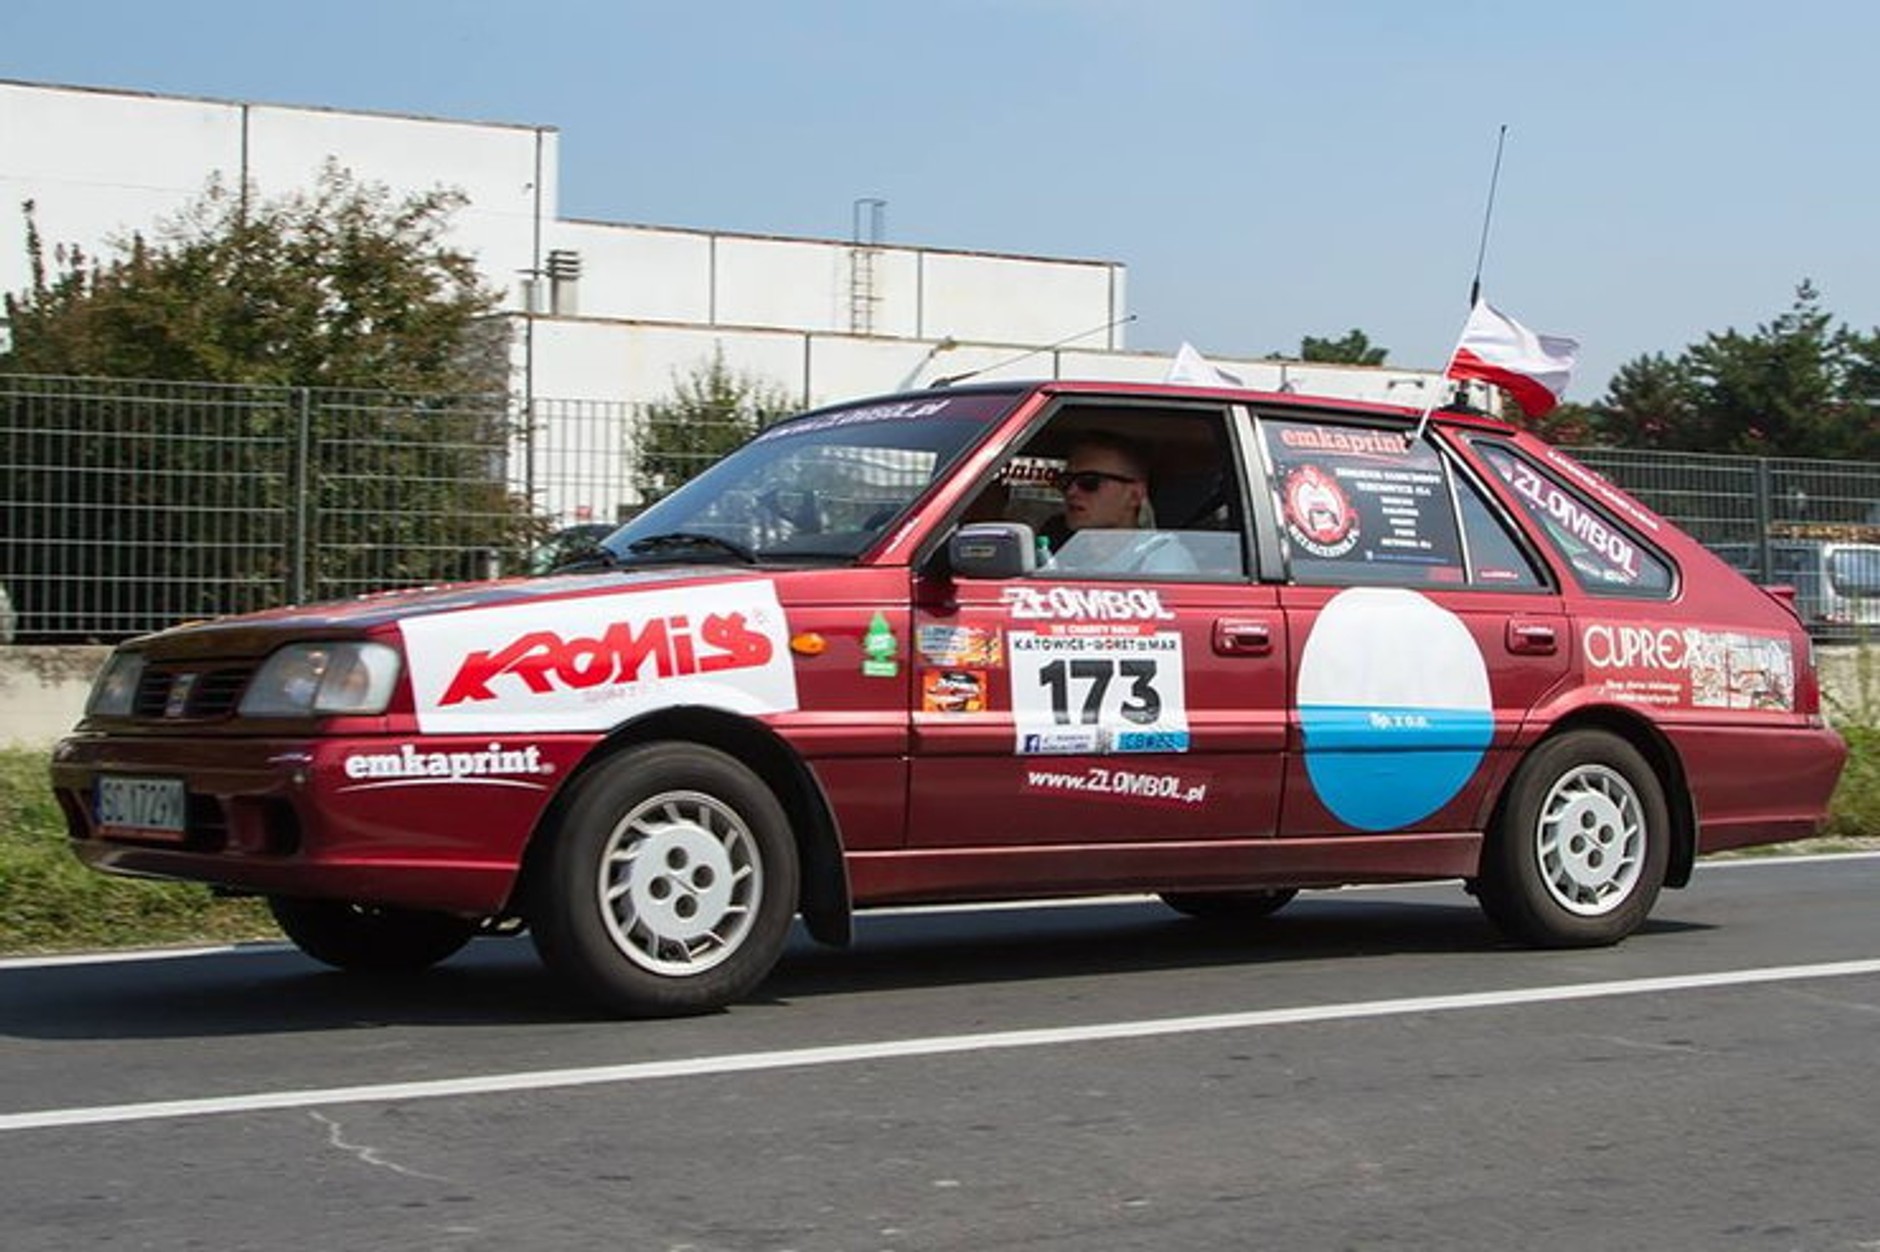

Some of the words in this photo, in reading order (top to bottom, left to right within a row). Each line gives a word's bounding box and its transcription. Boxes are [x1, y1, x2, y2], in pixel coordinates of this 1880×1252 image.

[1281, 426, 1409, 454] emkaprint
[1039, 658, 1162, 726] 173
[344, 743, 541, 779] emkaprint
